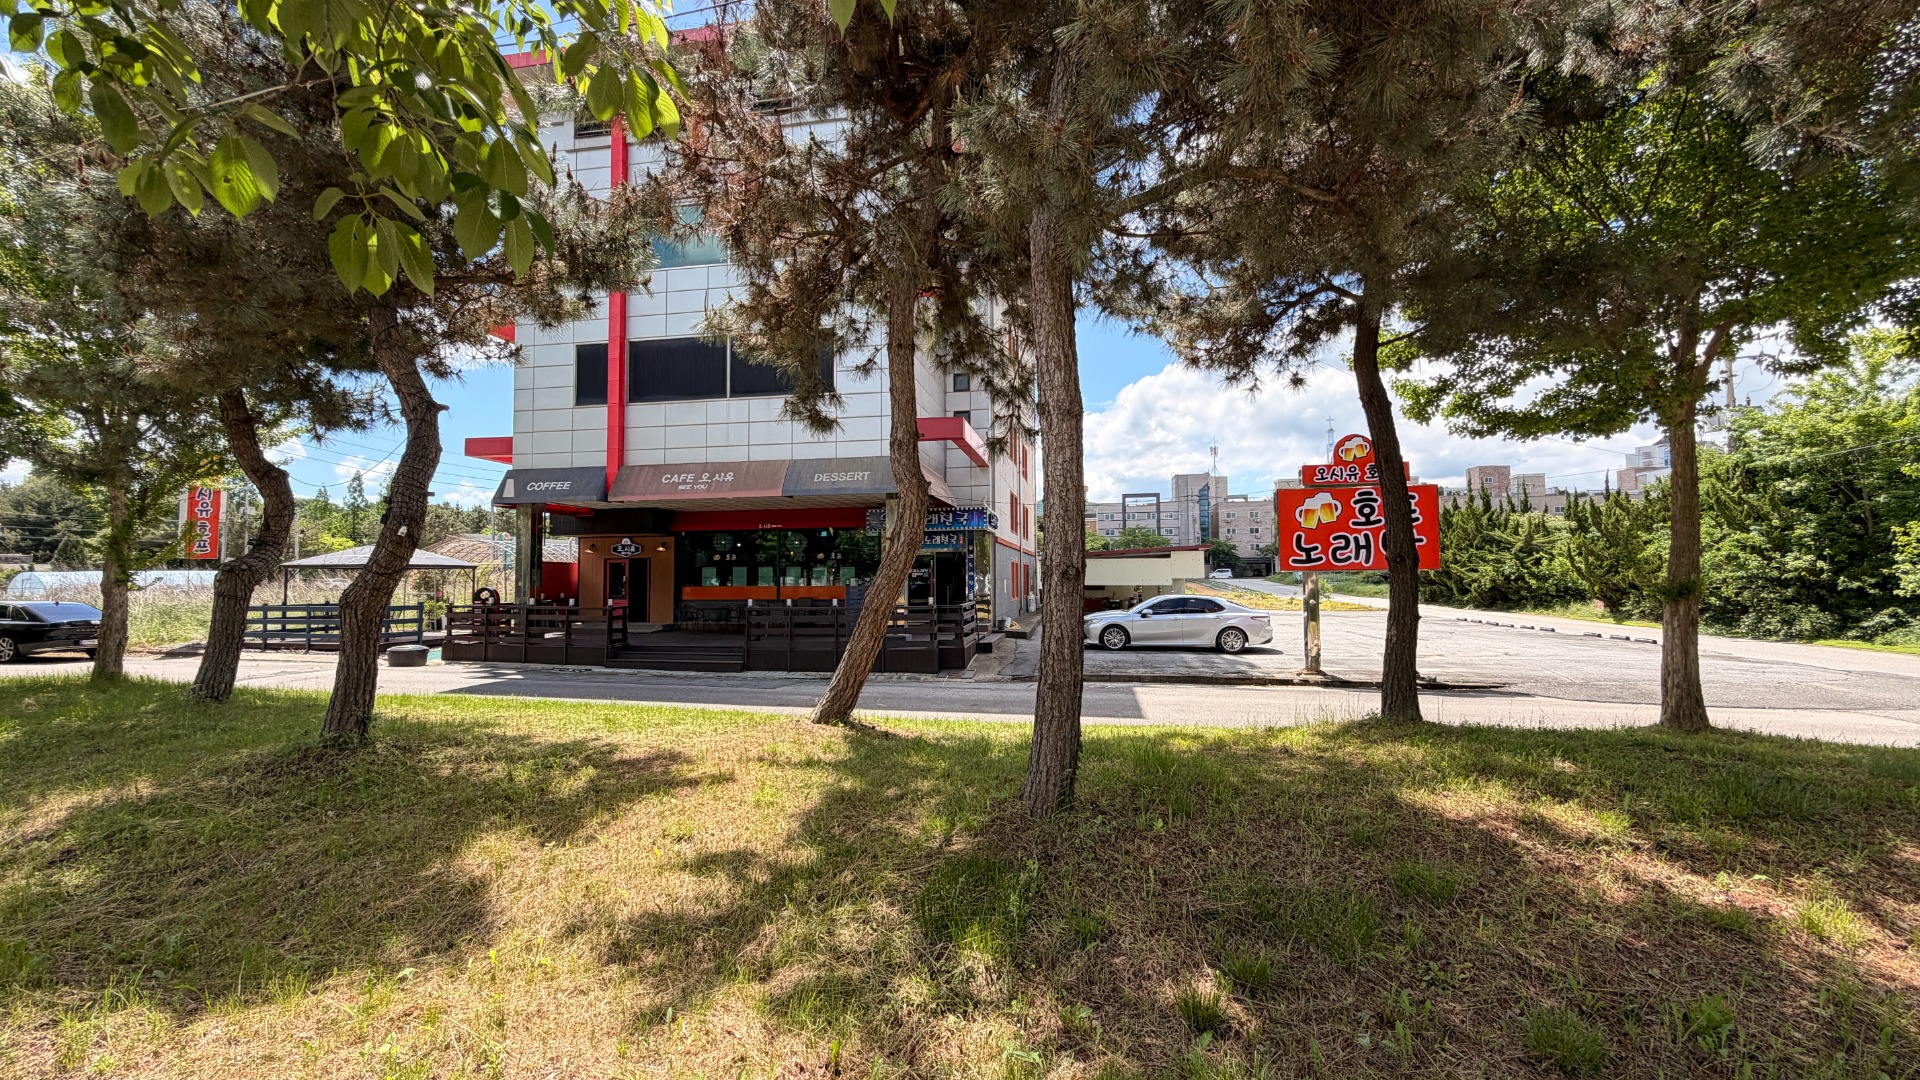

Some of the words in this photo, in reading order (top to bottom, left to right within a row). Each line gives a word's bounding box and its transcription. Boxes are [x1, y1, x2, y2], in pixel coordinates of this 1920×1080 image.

[661, 473, 695, 484] CAFE
[698, 471, 735, 483] 오시유
[813, 471, 871, 482] DESSERT
[1314, 465, 1361, 482] 오시유
[1364, 463, 1379, 481] 호
[526, 481, 572, 491] COFFEE
[195, 487, 213, 518] 시유
[921, 533, 957, 545] 노래천국
